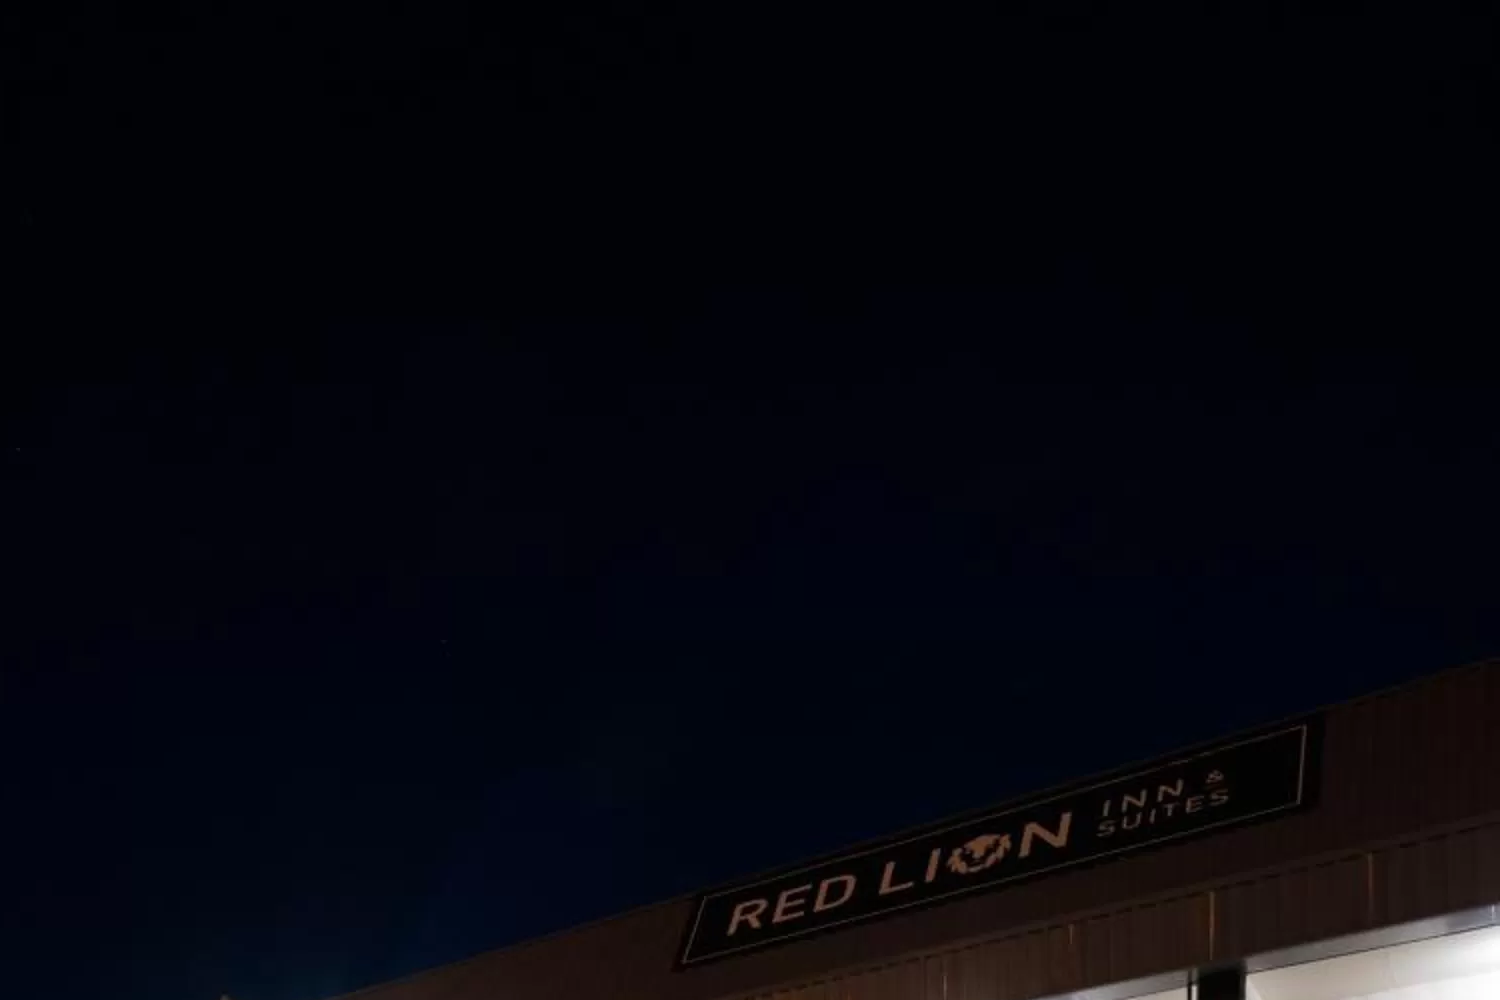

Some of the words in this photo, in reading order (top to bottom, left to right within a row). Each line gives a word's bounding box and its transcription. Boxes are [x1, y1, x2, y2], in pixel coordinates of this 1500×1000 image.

[1097, 789, 1231, 838] SUITES
[1102, 778, 1185, 817] INN
[1205, 768, 1226, 788] &
[726, 874, 857, 937] RED
[879, 811, 1073, 896] LION
